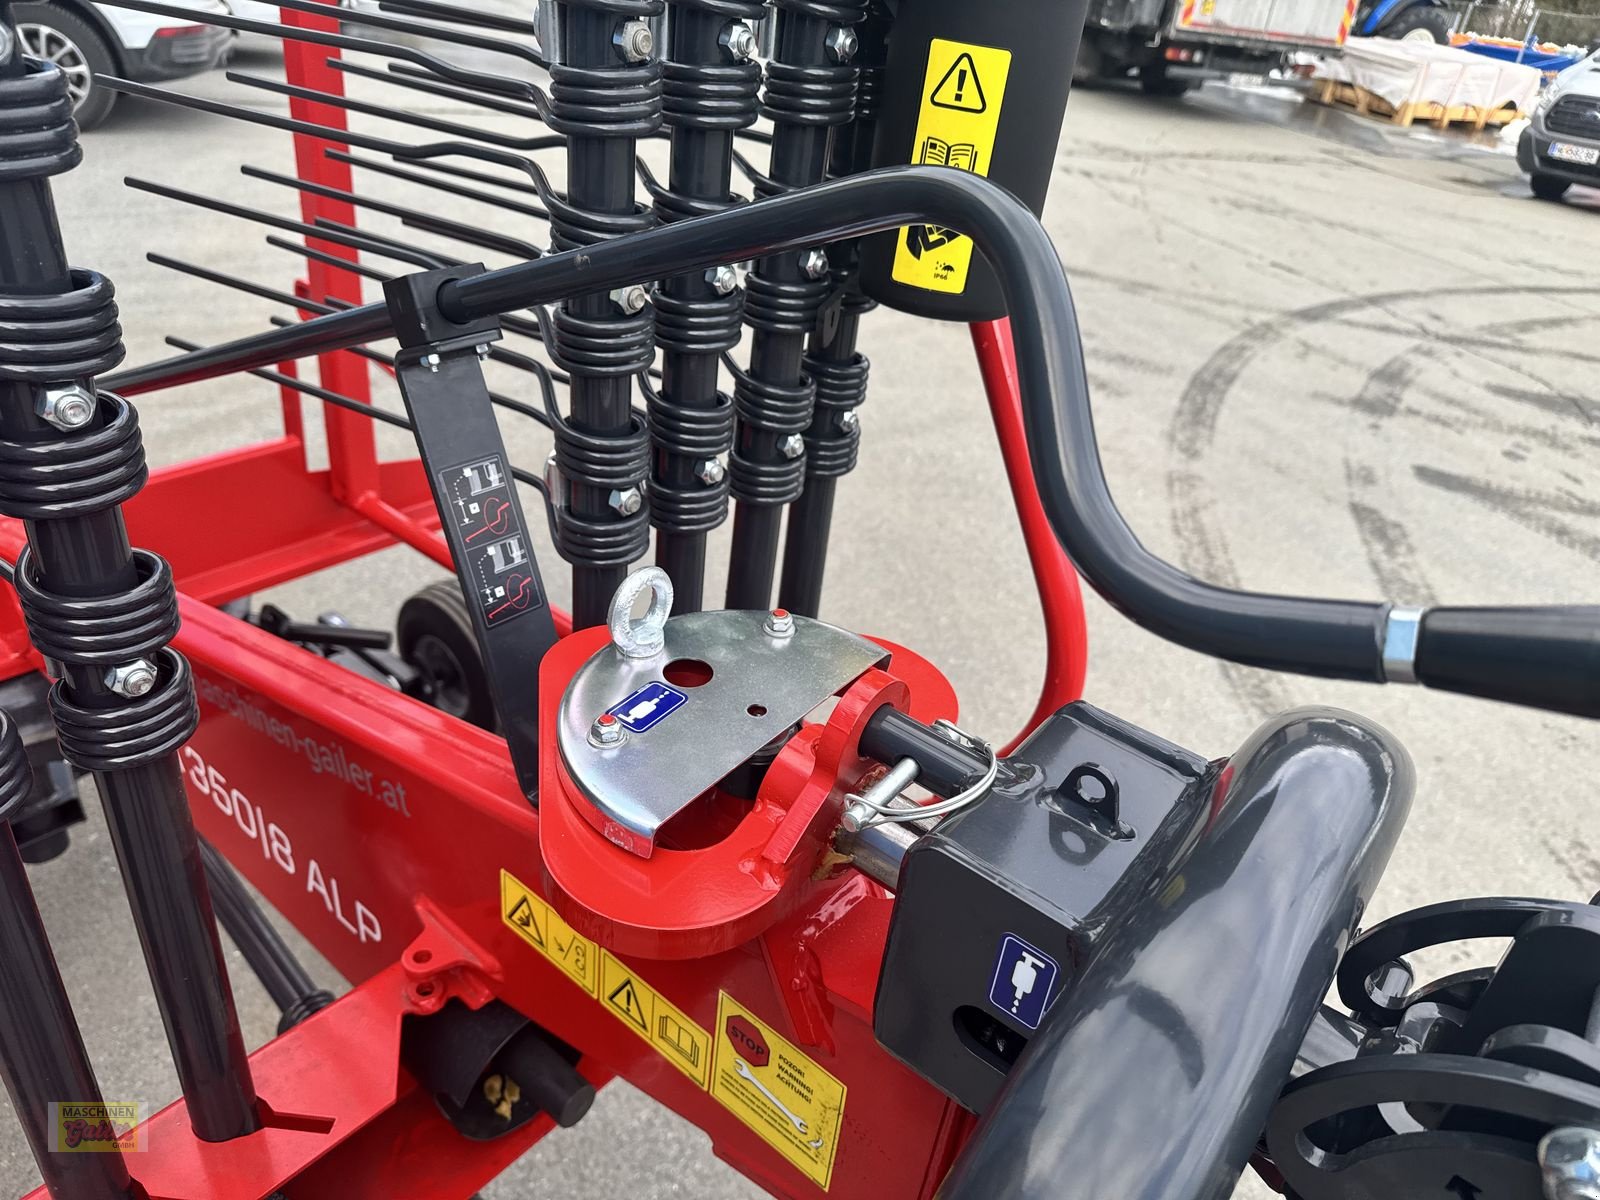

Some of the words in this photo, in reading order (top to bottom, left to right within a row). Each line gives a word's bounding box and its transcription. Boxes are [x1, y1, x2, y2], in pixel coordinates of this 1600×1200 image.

[307, 859, 382, 943] ALP
[731, 1025, 765, 1056] STOP
[777, 1063, 814, 1096] WARNING!
[778, 1054, 805, 1077] POZOR!
[775, 1073, 812, 1105] ACHTUNG!
